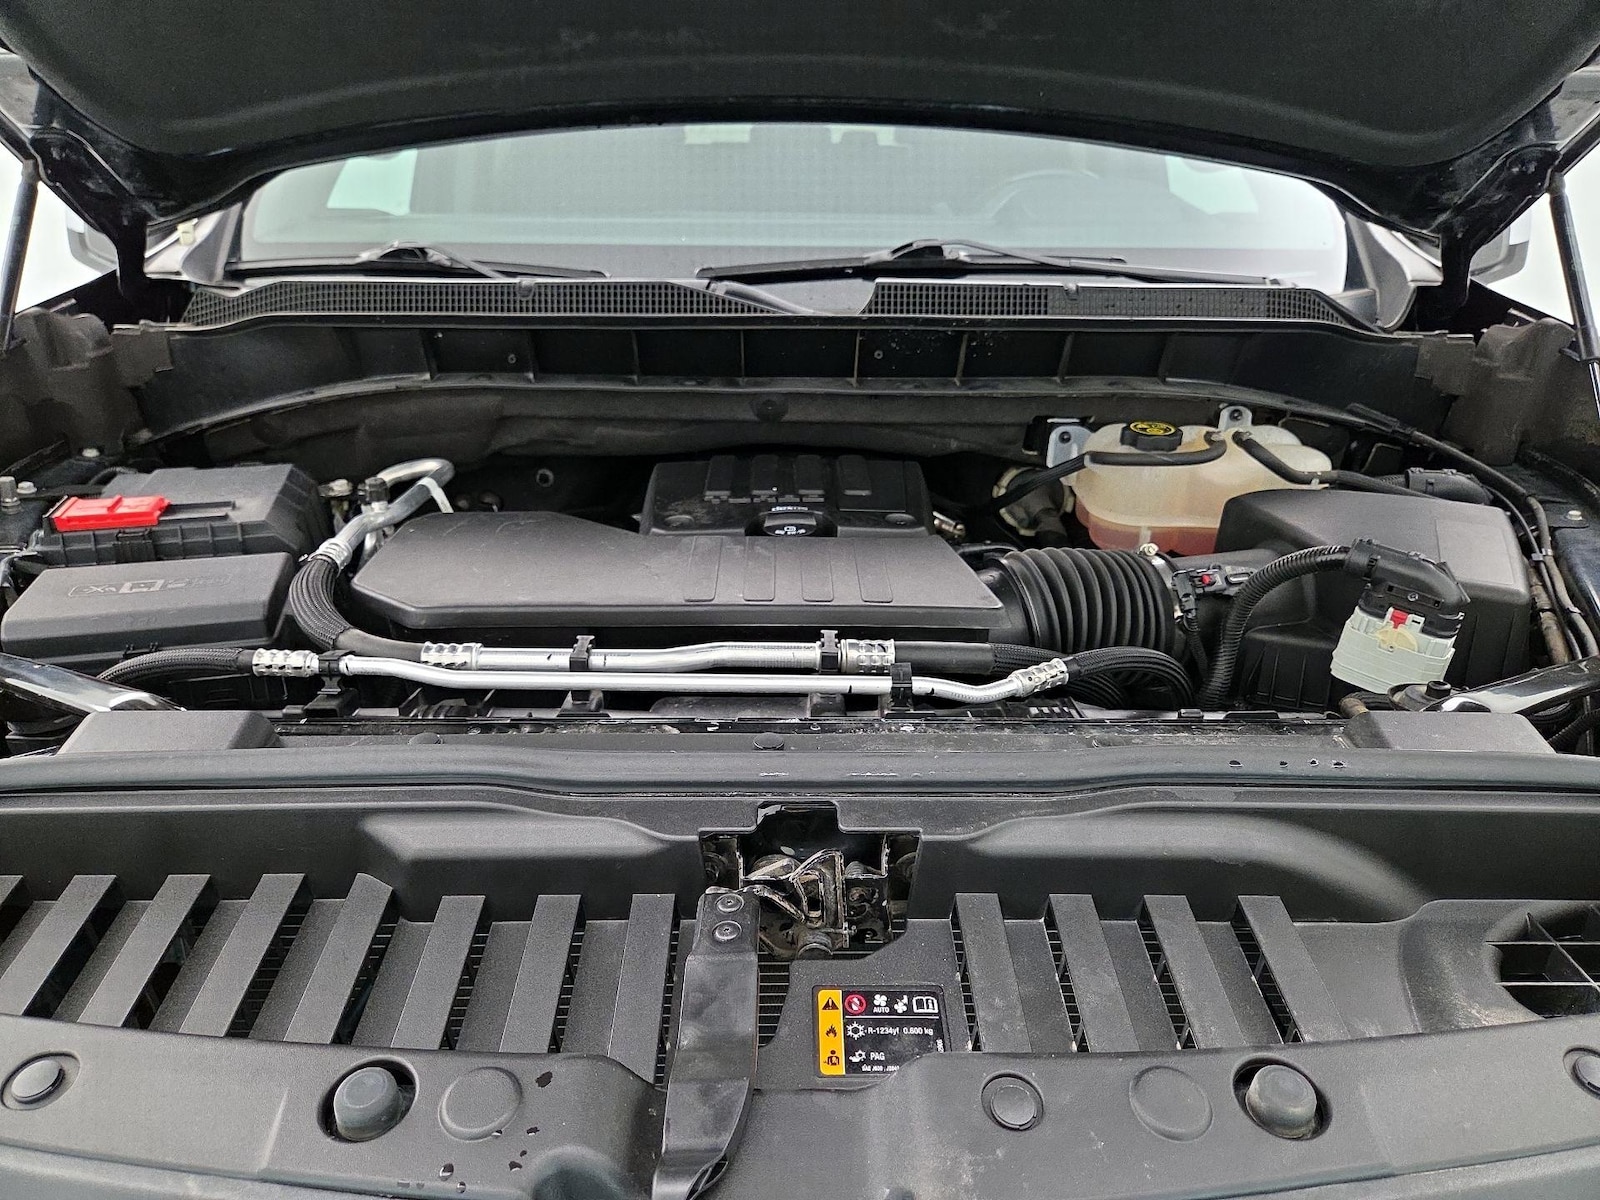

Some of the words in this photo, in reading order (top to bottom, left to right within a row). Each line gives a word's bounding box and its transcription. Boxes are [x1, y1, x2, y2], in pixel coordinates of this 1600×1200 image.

[867, 1027, 900, 1036] R-1234yf
[923, 1027, 934, 1036] kg
[870, 1052, 885, 1061] PAG
